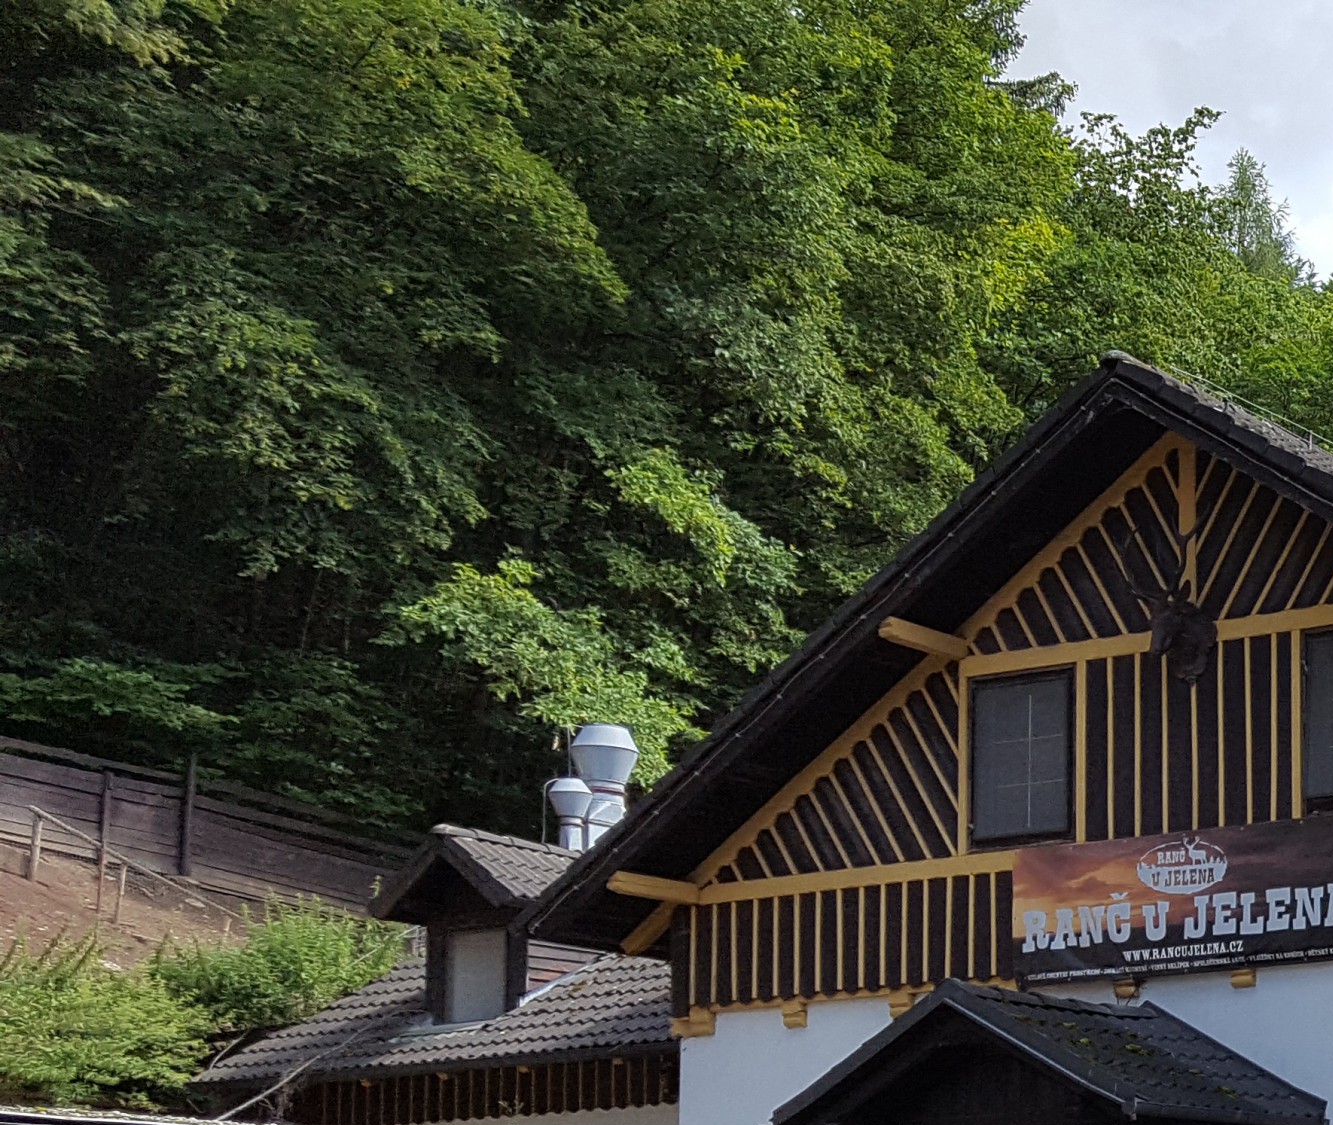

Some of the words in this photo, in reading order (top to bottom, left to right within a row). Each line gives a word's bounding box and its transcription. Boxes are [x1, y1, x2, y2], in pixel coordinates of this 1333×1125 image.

[1157, 847, 1186, 865] RANČ
[1151, 871, 1160, 886] U
[1164, 867, 1215, 887] JELENA
[1022, 892, 1132, 954] RANČ
[1142, 901, 1170, 942] U
[1122, 941, 1244, 963] WWW.RANCUJELENA.CZ
